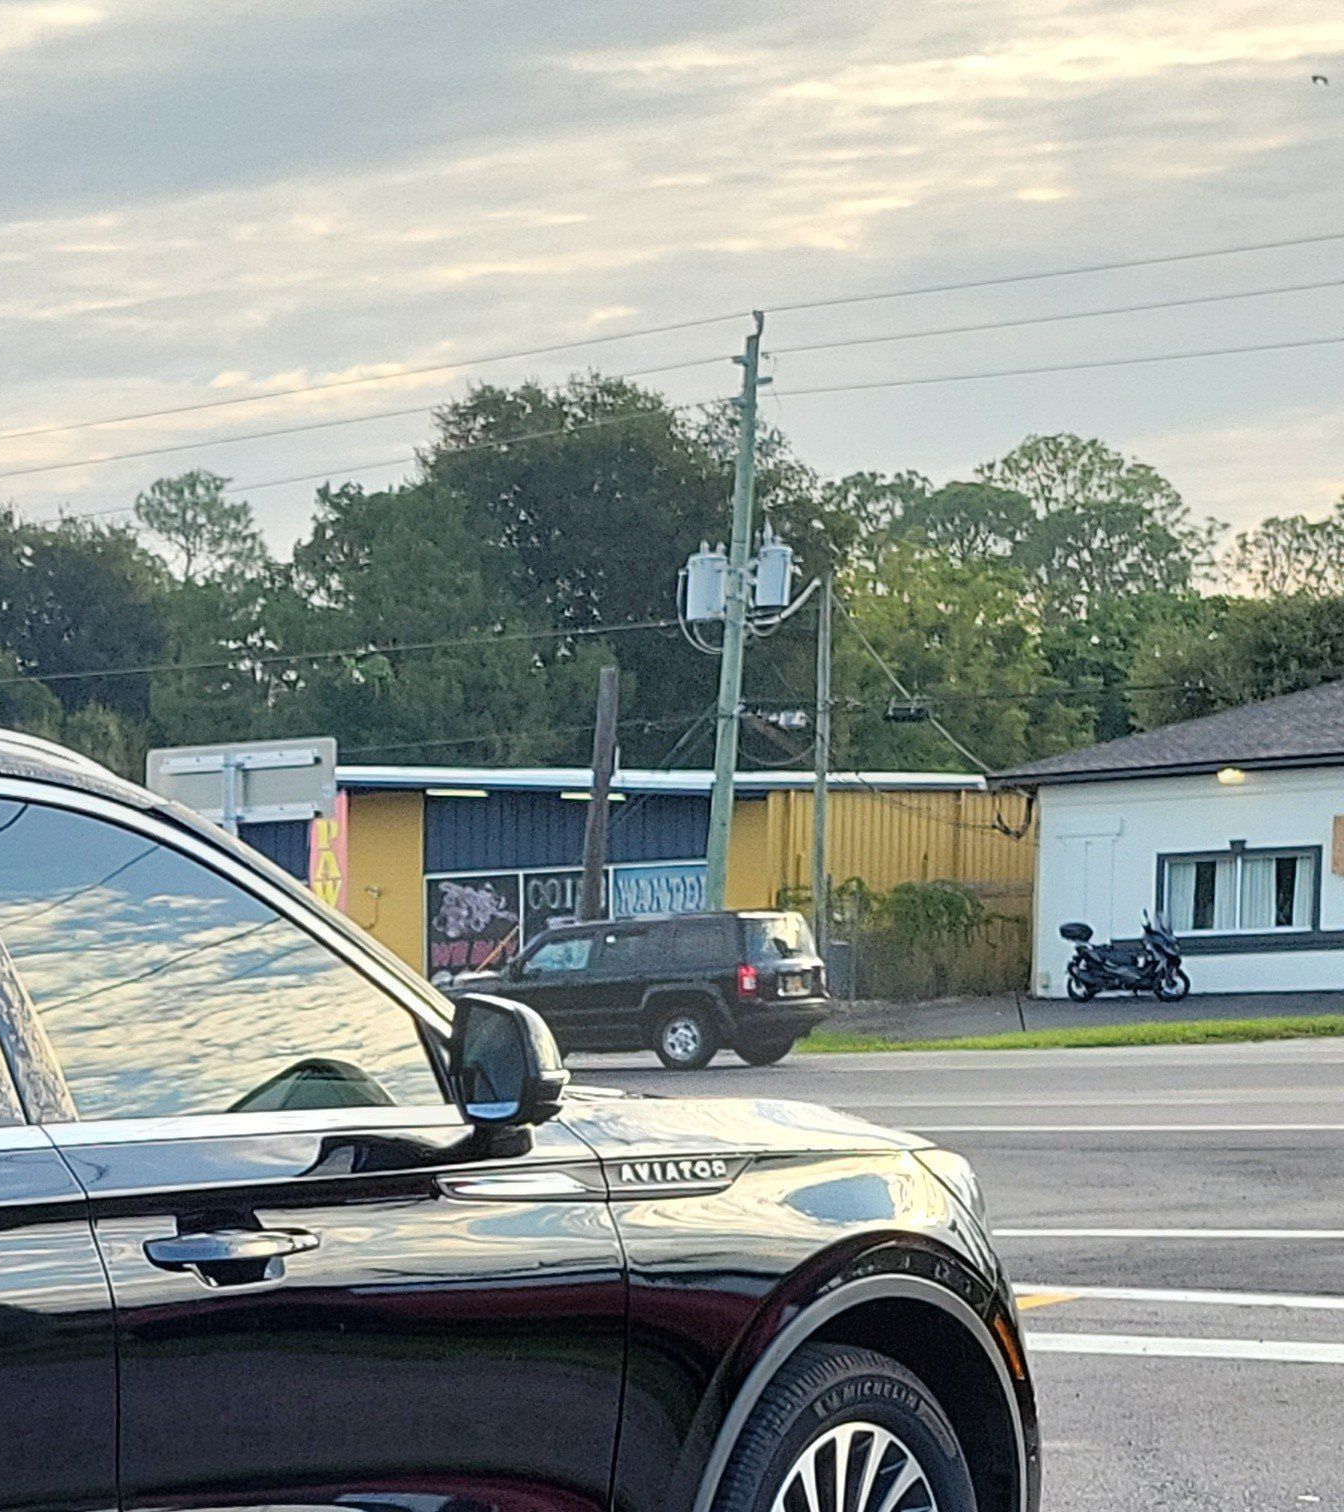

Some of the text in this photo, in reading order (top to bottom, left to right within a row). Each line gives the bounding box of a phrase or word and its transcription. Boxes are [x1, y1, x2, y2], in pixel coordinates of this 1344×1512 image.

[528, 878, 607, 911] COI
[620, 1160, 727, 1182] AVIATOR
[843, 1382, 919, 1409] MICHELIN
